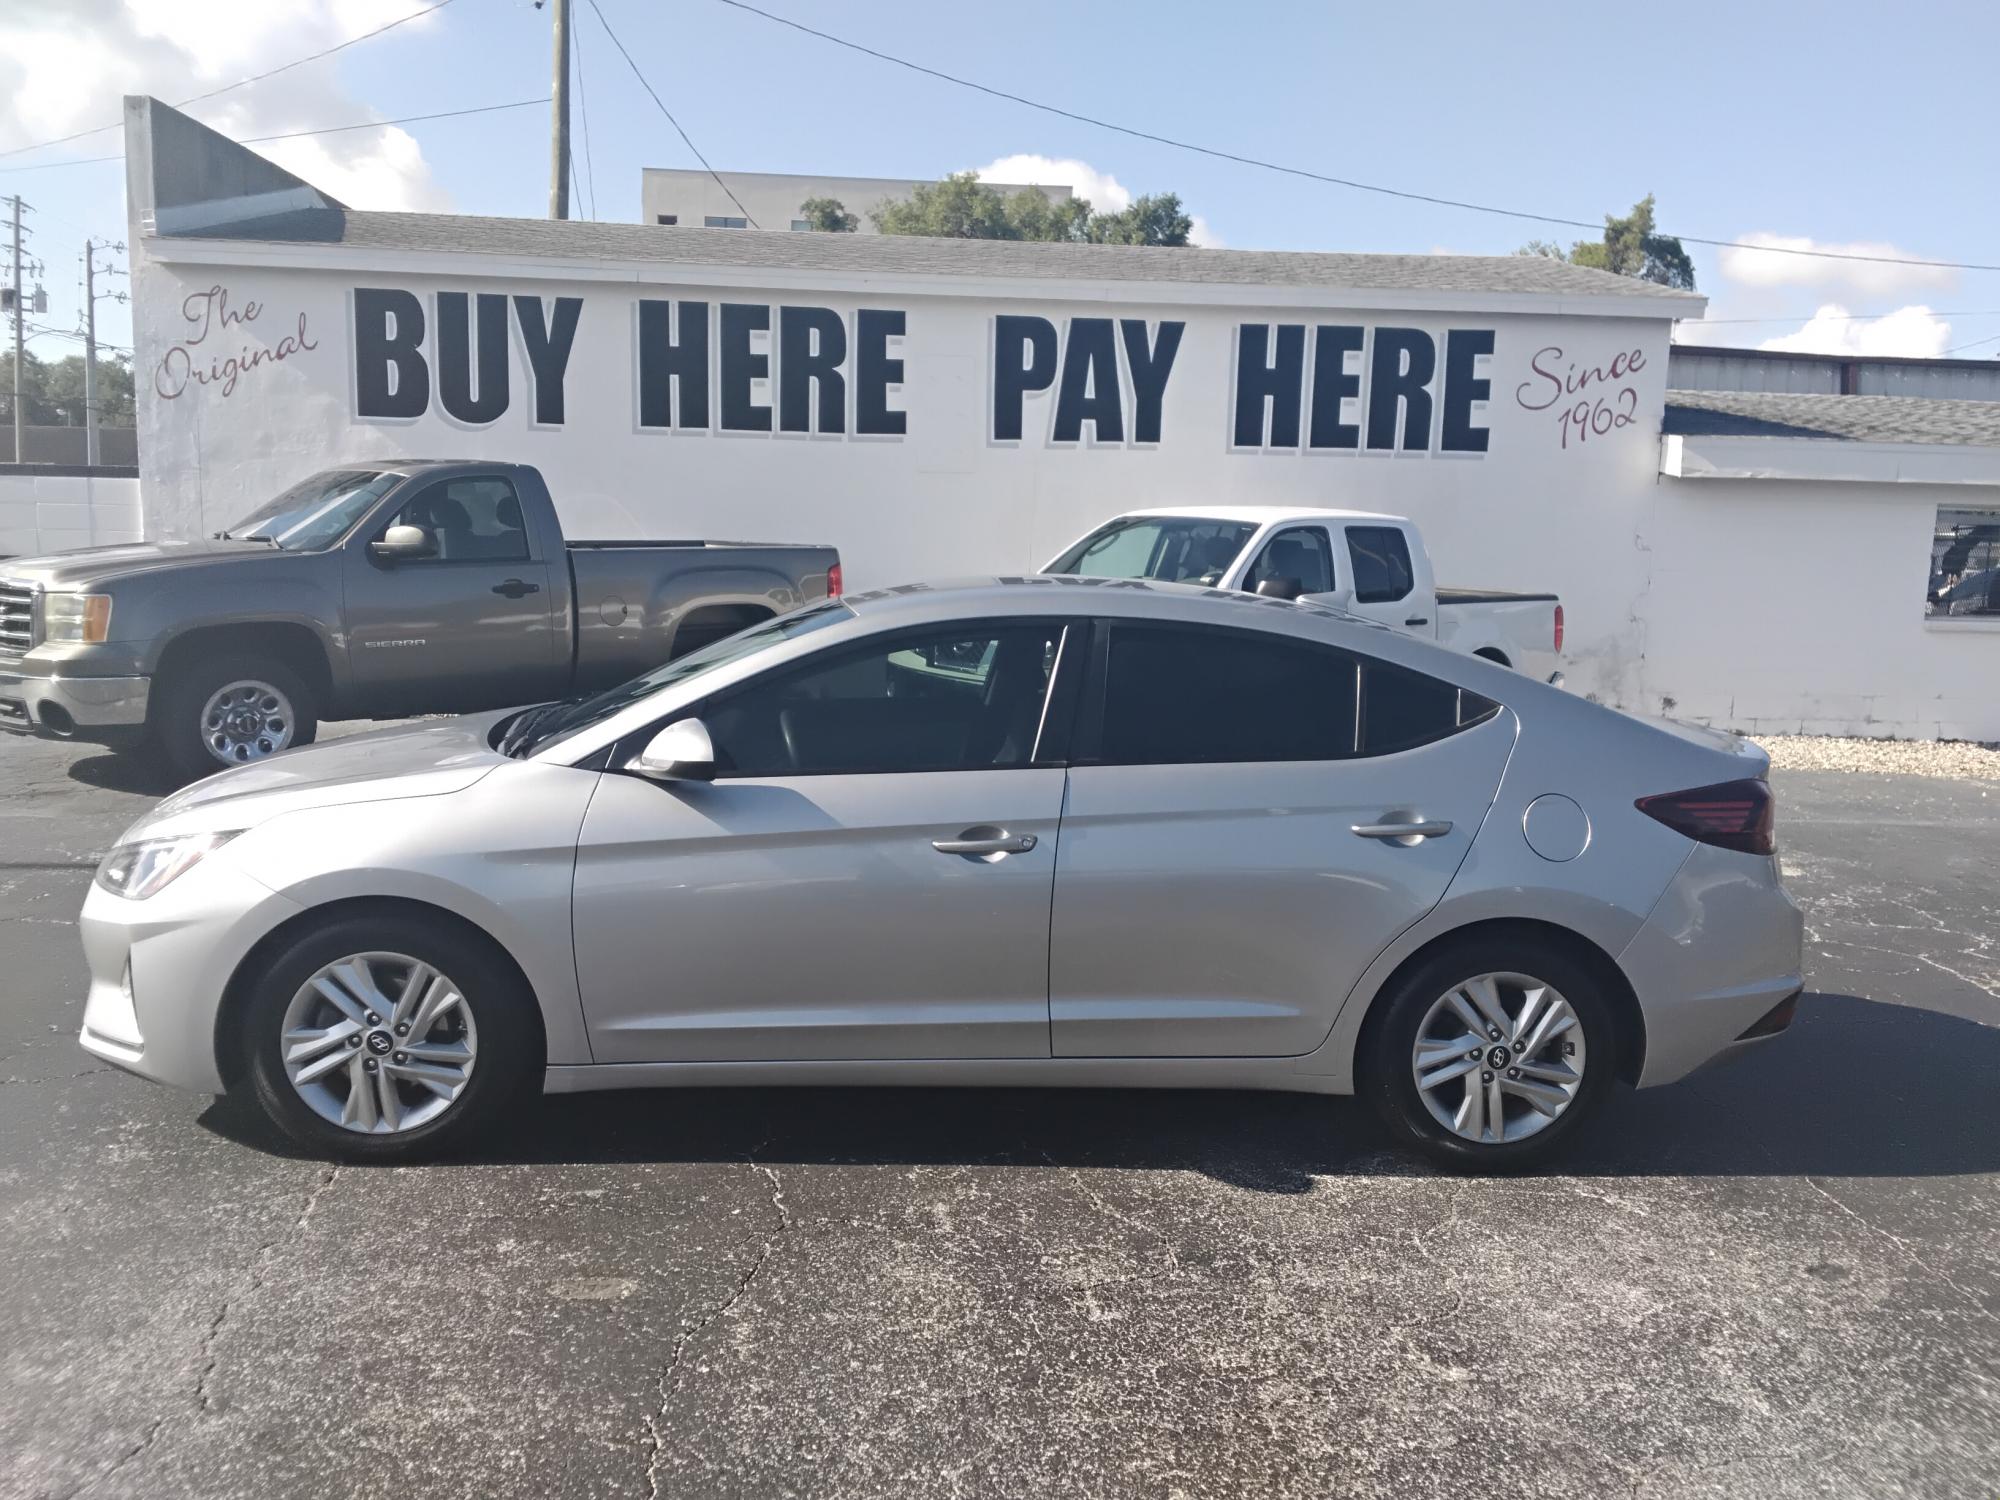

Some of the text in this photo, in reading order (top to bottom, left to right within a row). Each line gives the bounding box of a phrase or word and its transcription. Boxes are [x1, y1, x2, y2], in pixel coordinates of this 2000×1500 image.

[182, 284, 263, 345] The
[155, 311, 318, 400] Original
[353, 287, 1496, 452] BUY HERE PAY HERE
[1516, 347, 1647, 411] Since
[1558, 387, 1638, 450] 1962
[364, 639, 426, 649] SIERRA
